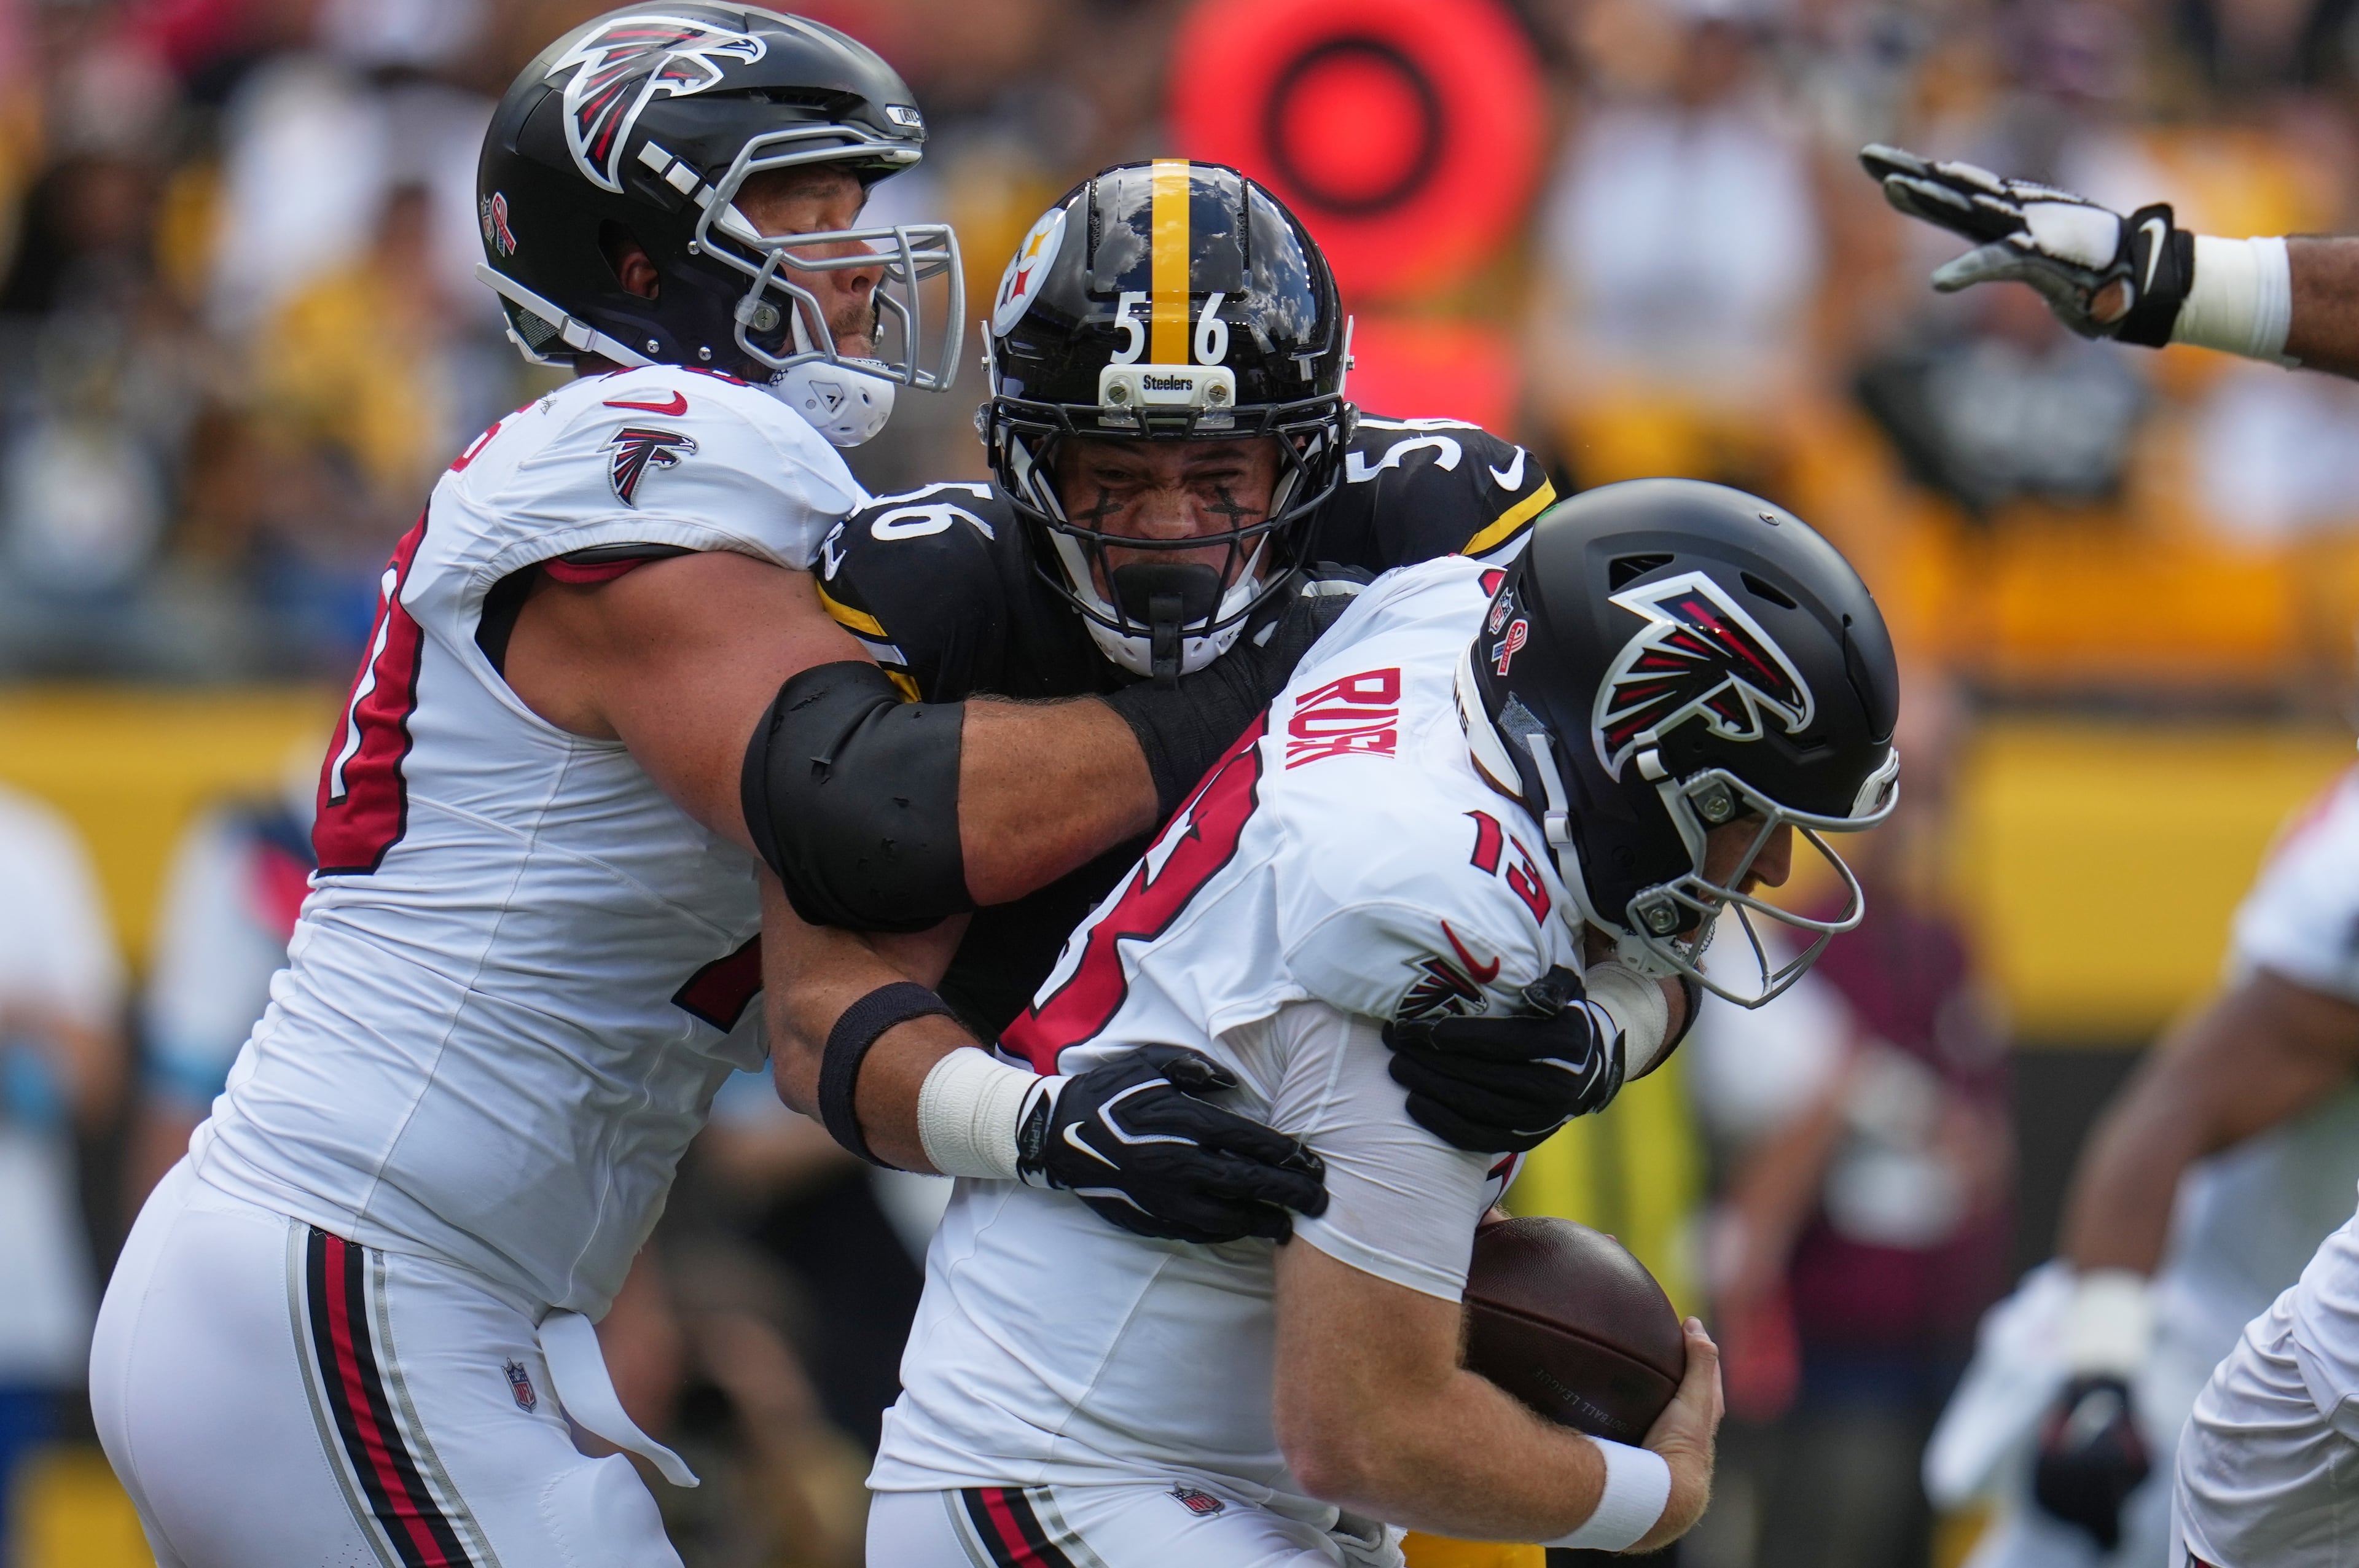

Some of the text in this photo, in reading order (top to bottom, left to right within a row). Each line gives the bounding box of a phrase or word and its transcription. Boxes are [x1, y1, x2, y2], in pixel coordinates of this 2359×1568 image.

[1143, 374, 1193, 391] Steelers
[1461, 809, 1551, 928] 13
[1028, 1109, 1043, 1161] ALPHA
[514, 1383, 534, 1404] NFL
[1534, 1367, 1581, 1405] LEAGUE
[1185, 1495, 1218, 1510] NFL
